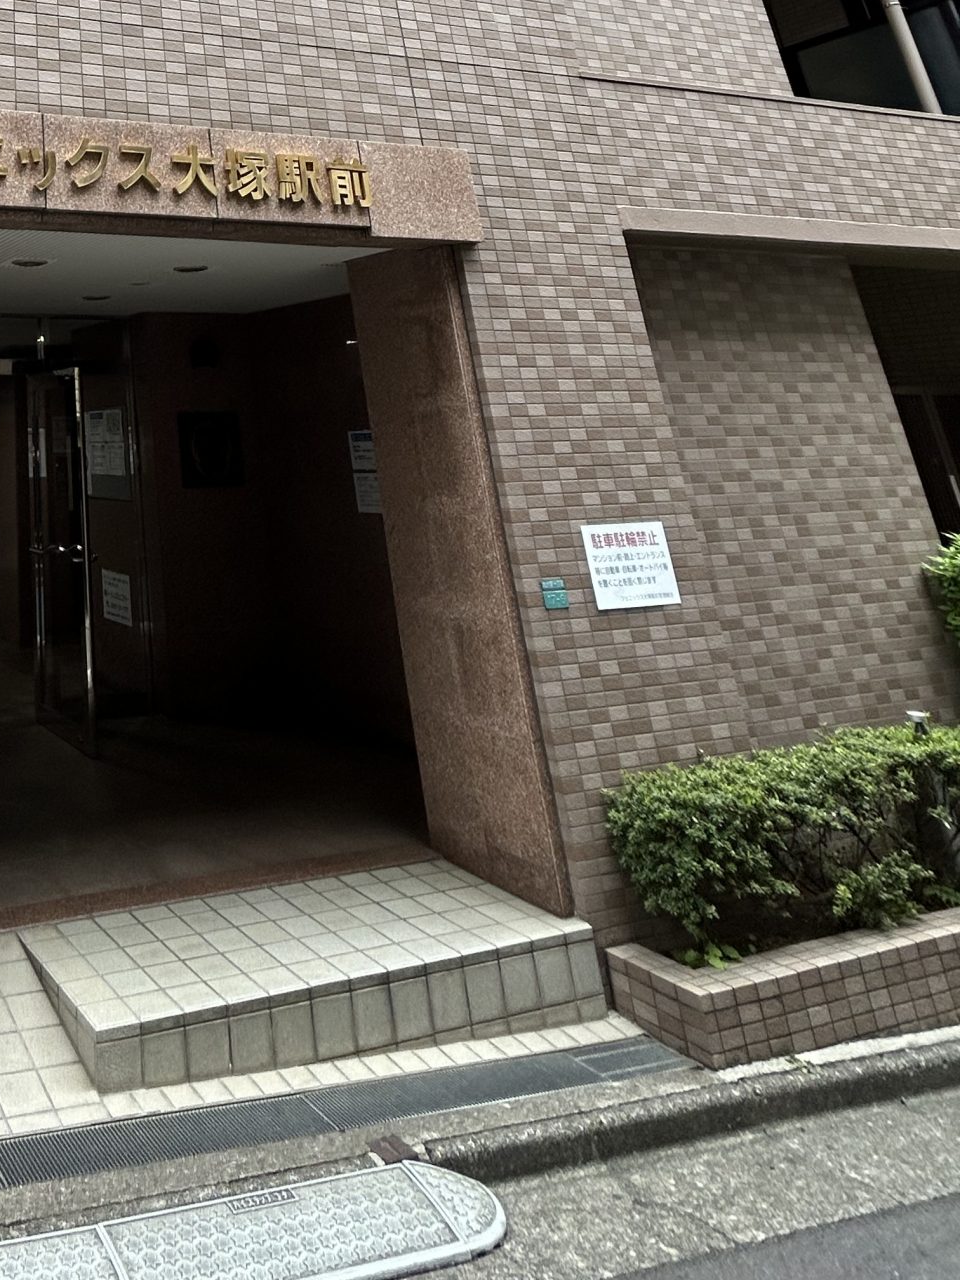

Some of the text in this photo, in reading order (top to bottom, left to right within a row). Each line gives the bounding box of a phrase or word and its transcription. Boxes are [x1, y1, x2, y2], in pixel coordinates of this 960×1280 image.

[590, 530, 660, 550] 駐車駐輪禁止
